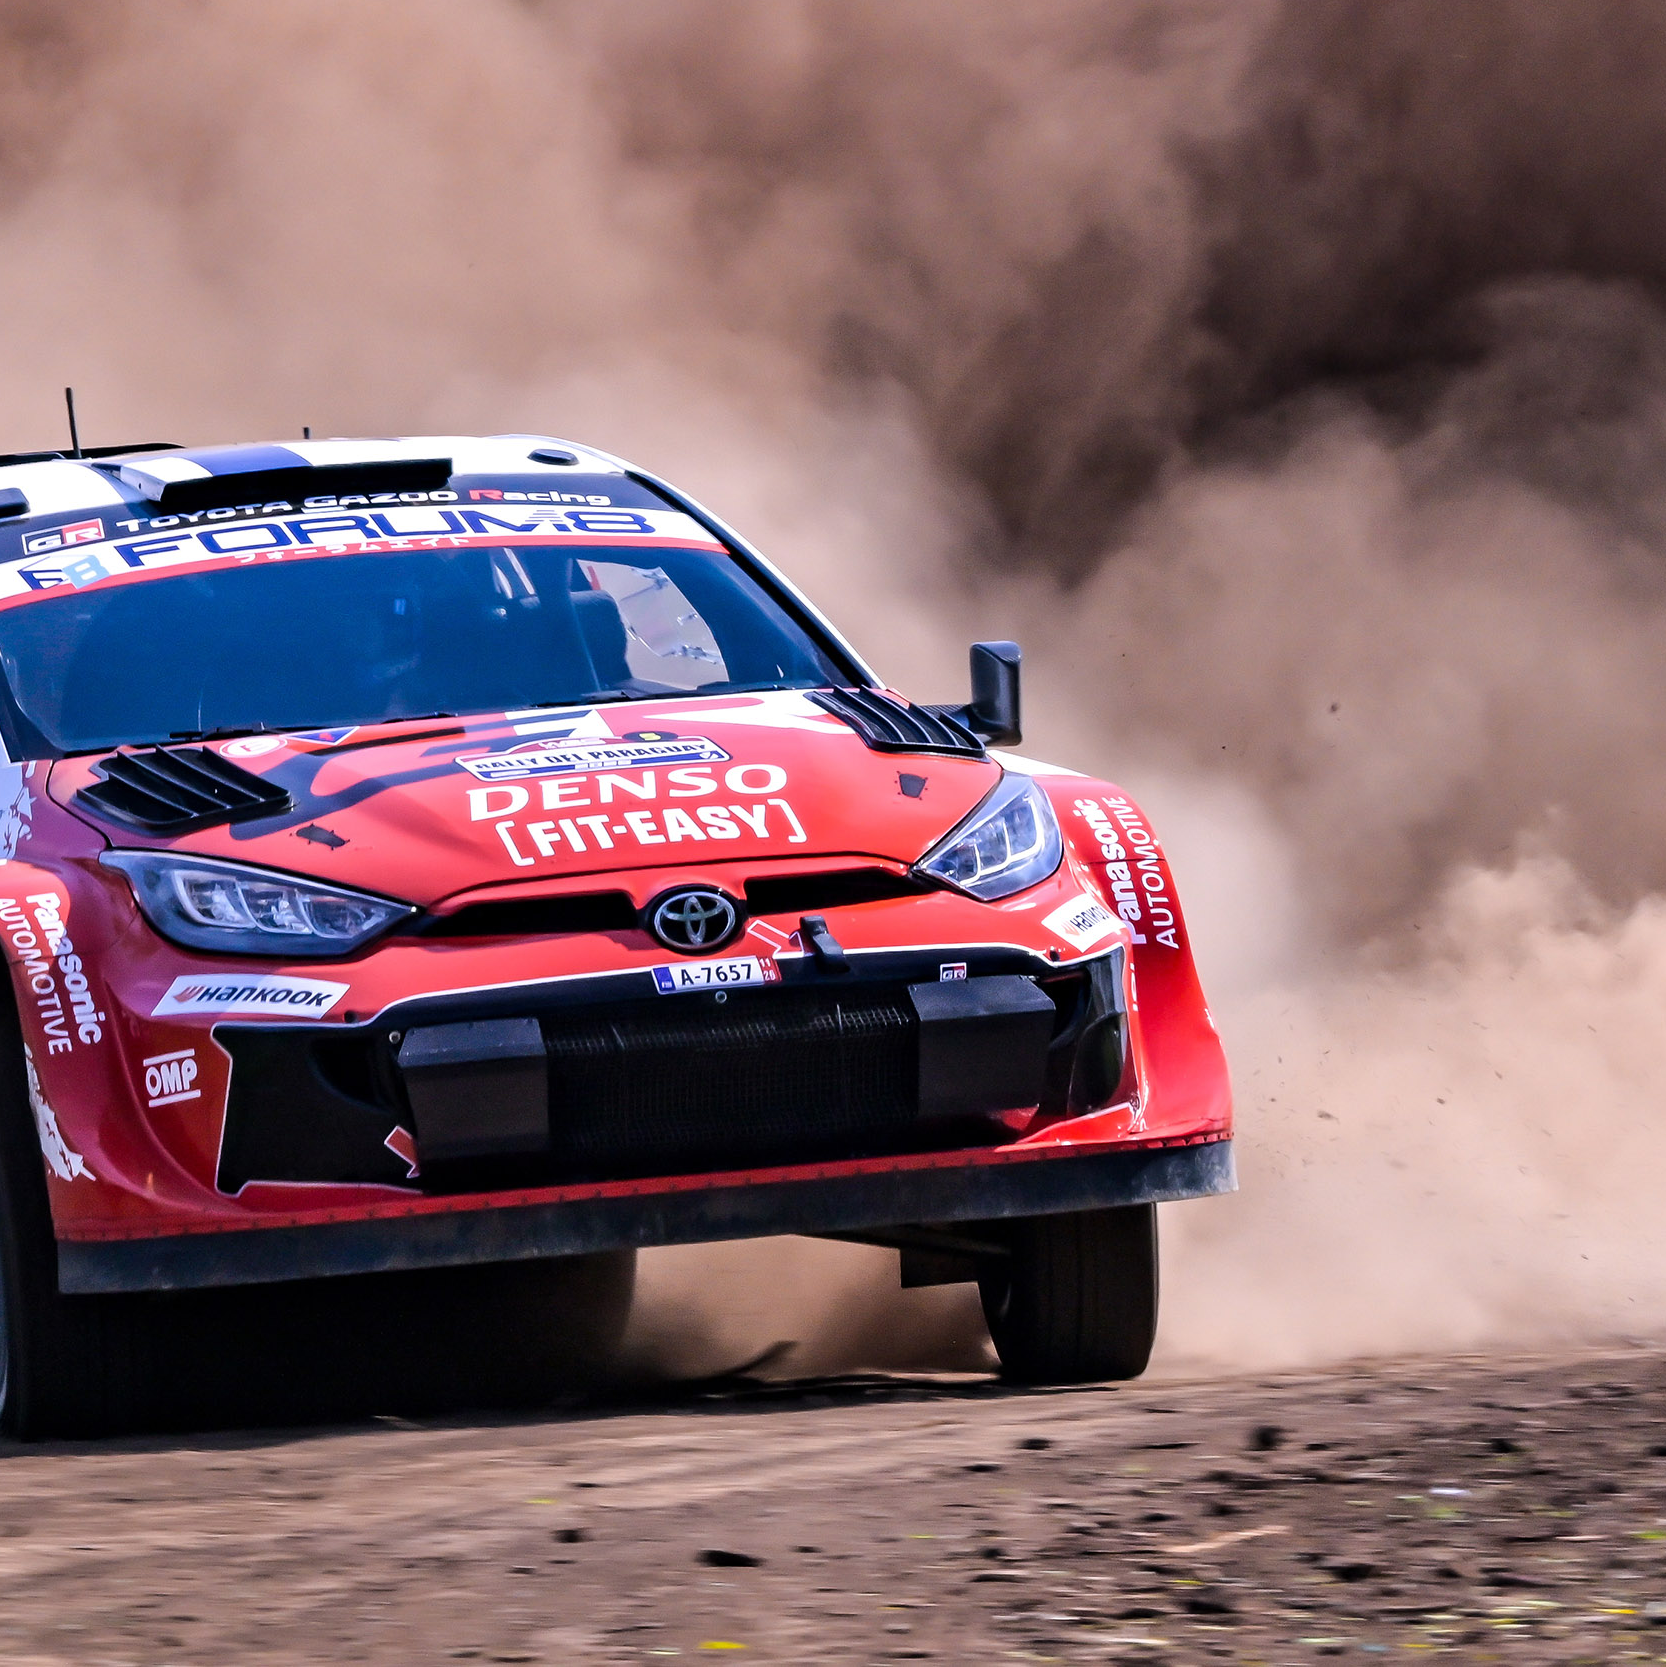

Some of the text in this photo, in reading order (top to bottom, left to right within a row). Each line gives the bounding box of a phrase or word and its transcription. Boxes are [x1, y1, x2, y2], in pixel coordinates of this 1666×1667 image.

[28, 489, 612, 552] GR TOYOTA GAZOO Racing
[113, 510, 656, 568] FORUM8
[465, 763, 788, 822] DENSO
[1073, 798, 1148, 945] Panasonic
[1102, 795, 1179, 949] AUTOMOTIVE
[25, 892, 106, 1045] Panasonic
[680, 963, 752, 986] A-7657
[942, 967, 966, 981] GR
[145, 1057, 198, 1098] OMP
